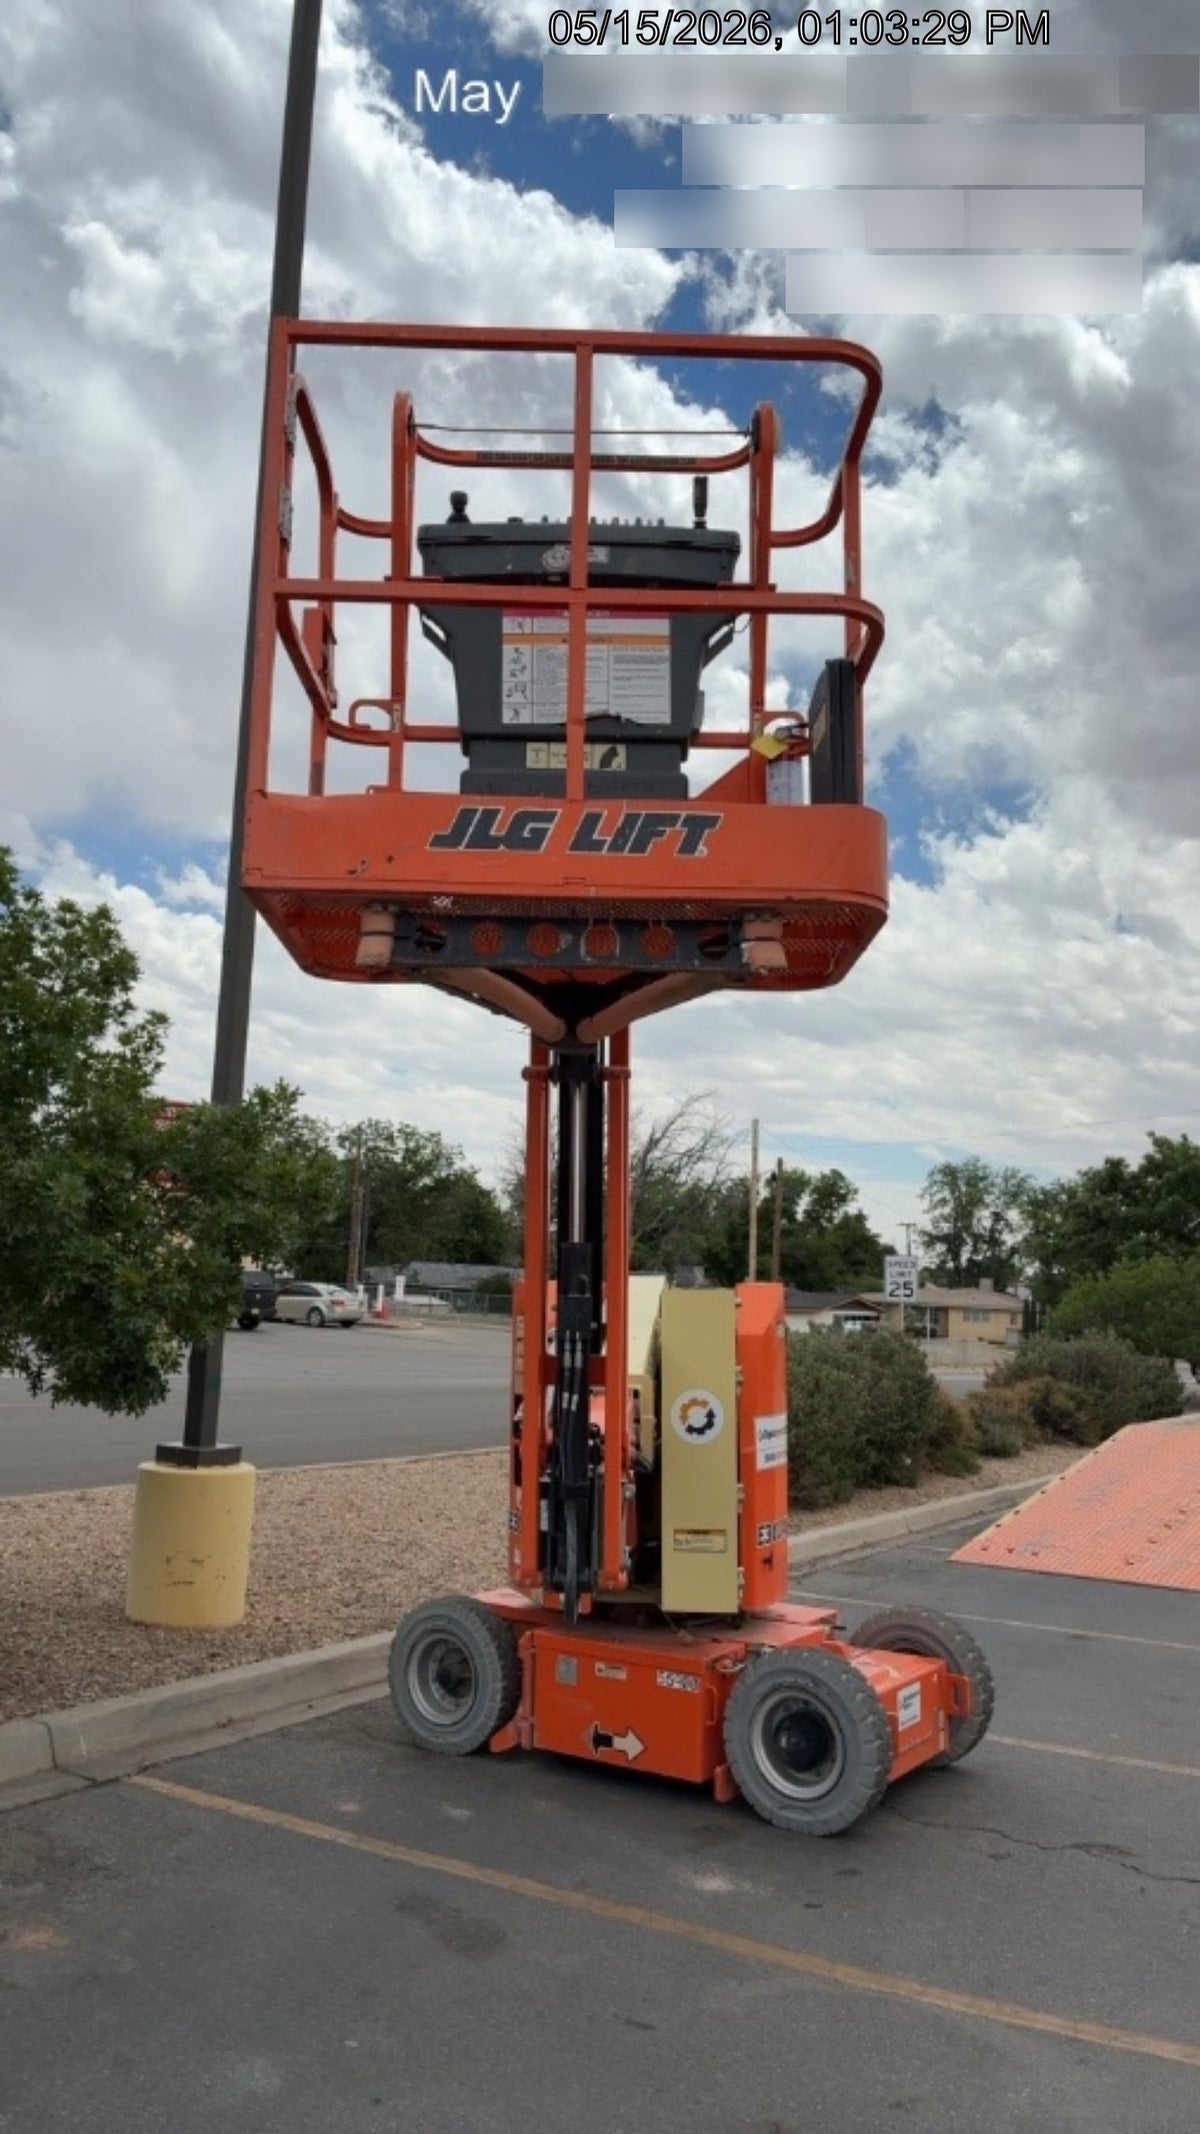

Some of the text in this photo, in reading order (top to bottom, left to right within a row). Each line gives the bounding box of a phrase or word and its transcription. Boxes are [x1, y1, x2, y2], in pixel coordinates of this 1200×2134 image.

[425, 805, 724, 857] JLG LIFT
[888, 1280, 914, 1298] 25
